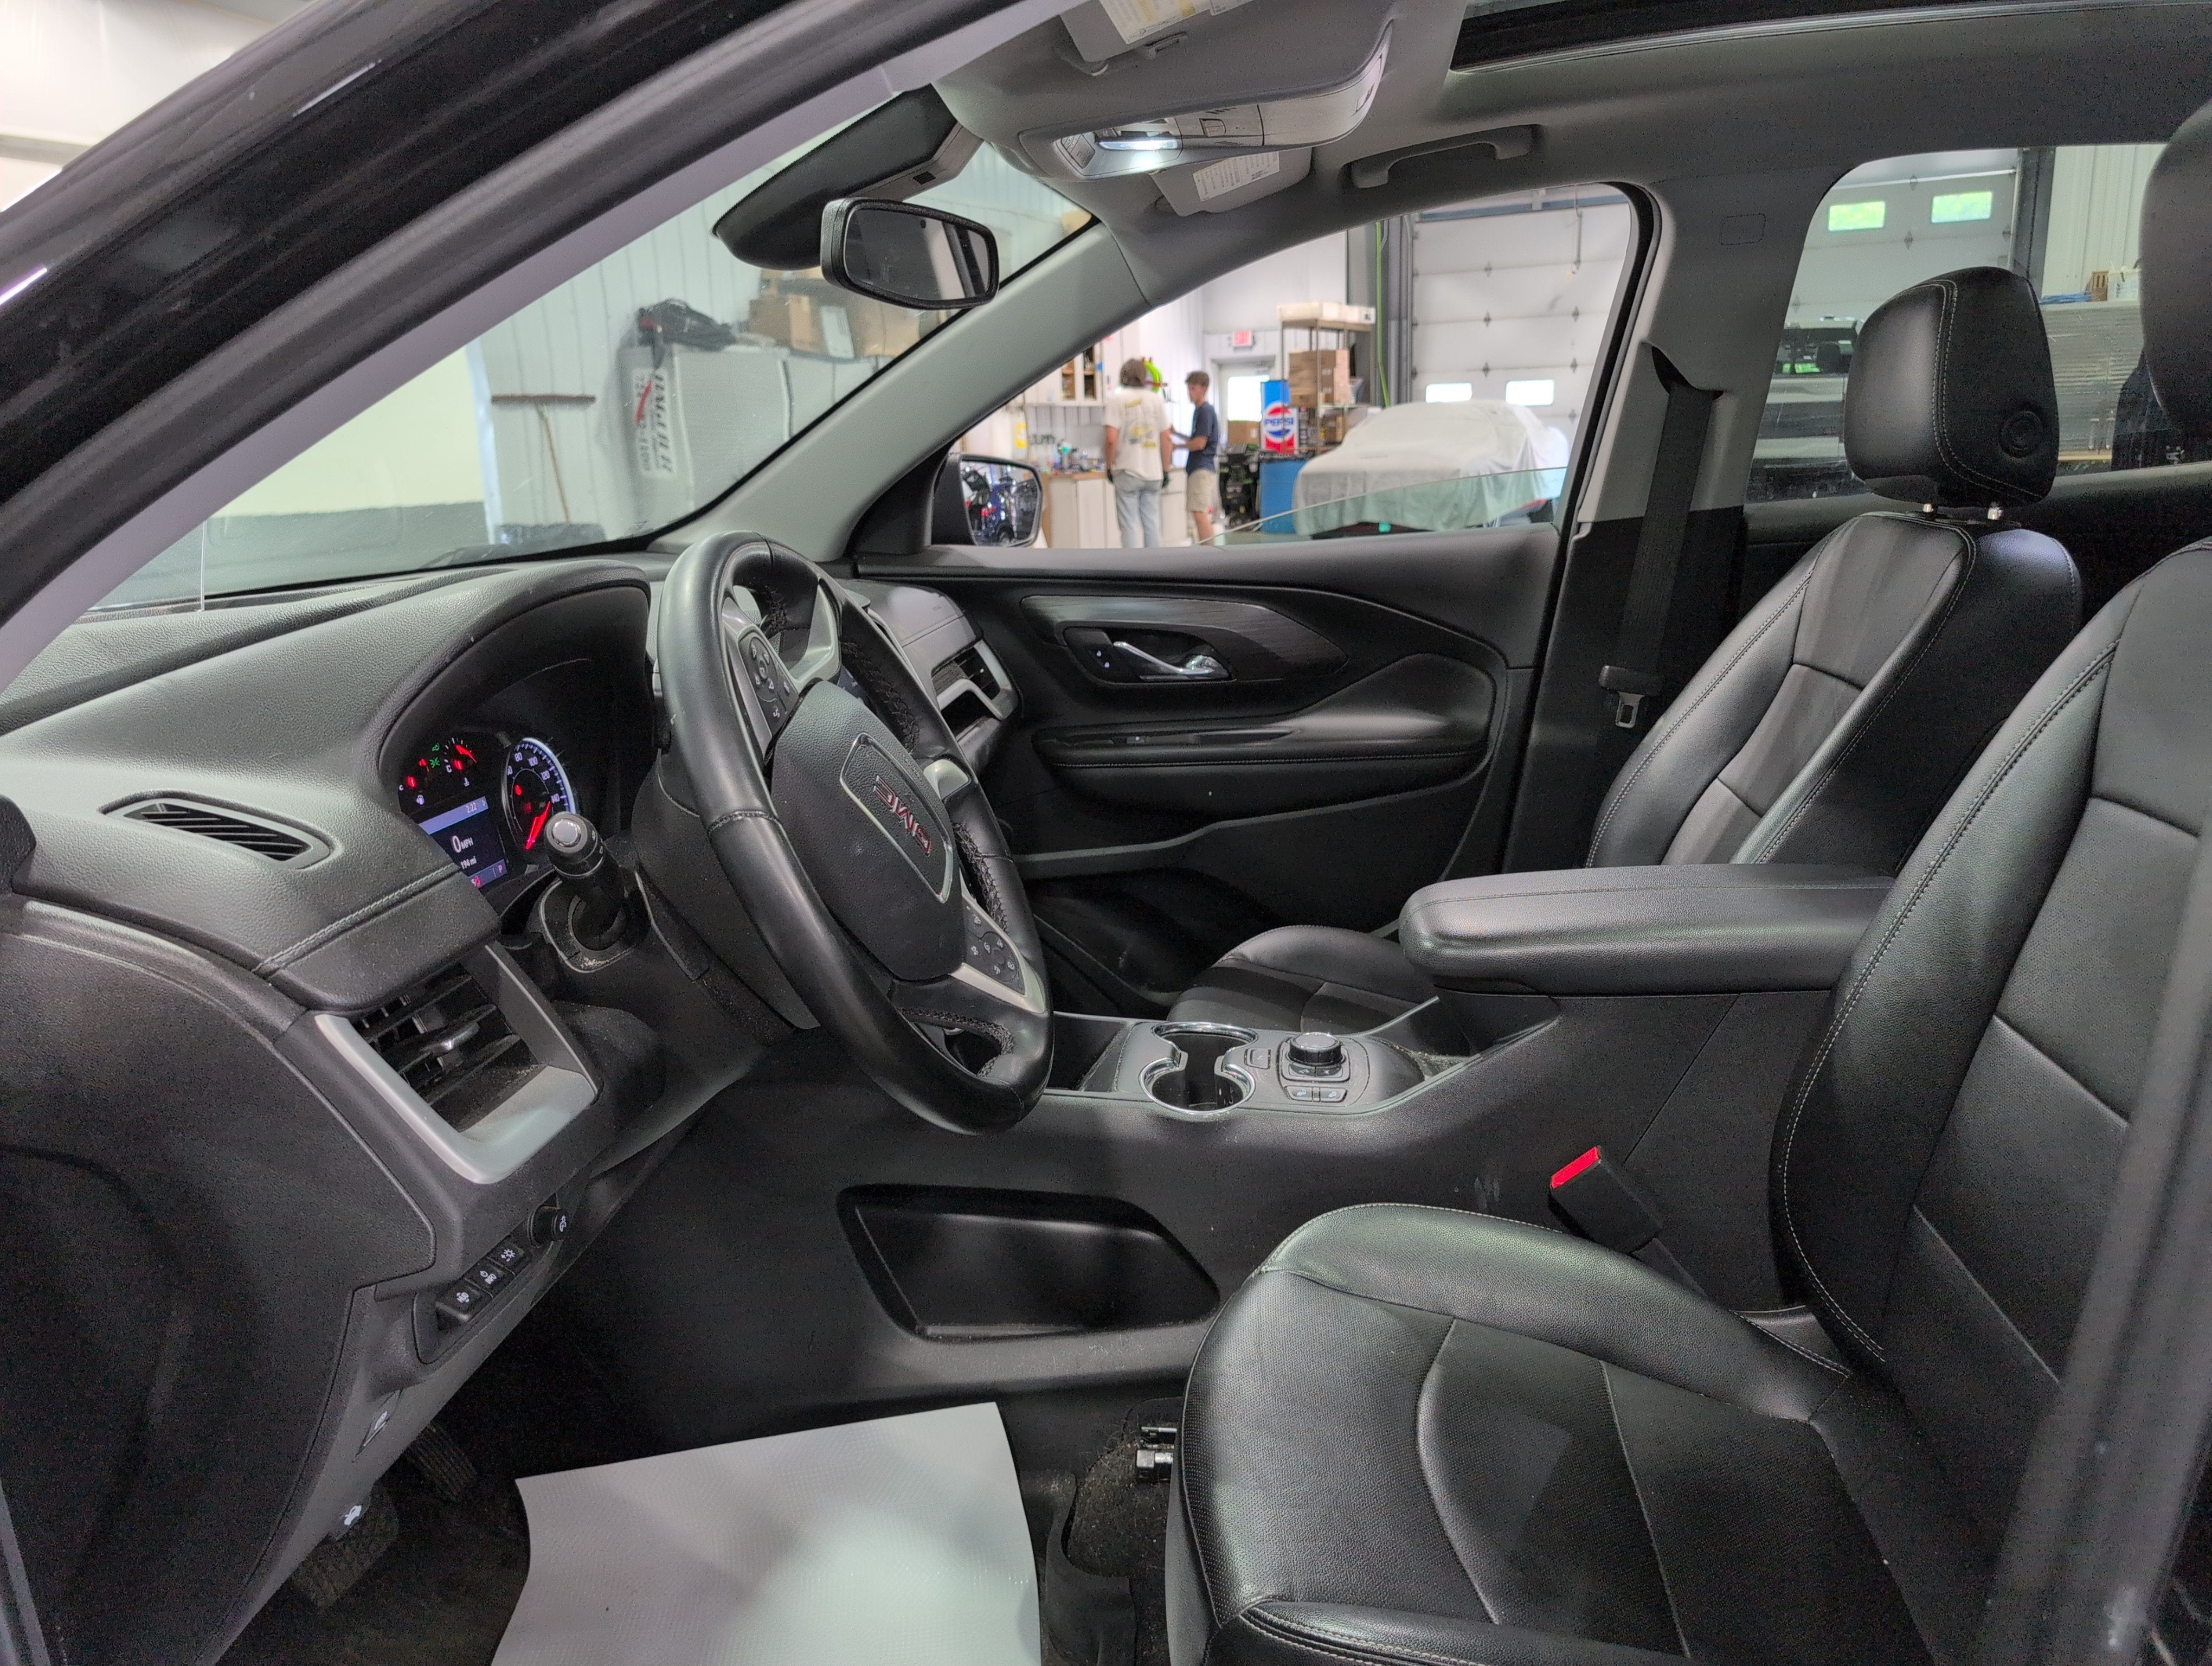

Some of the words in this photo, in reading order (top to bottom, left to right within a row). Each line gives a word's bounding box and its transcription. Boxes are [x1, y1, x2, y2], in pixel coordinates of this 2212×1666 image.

[515, 752, 523, 762] 80
[541, 770, 550, 780] 120
[551, 793, 560, 804] 140
[466, 803, 477, 813] 2:22
[873, 775, 931, 855] GMC
[461, 858, 471, 870] 194
[498, 864, 503, 873] P
